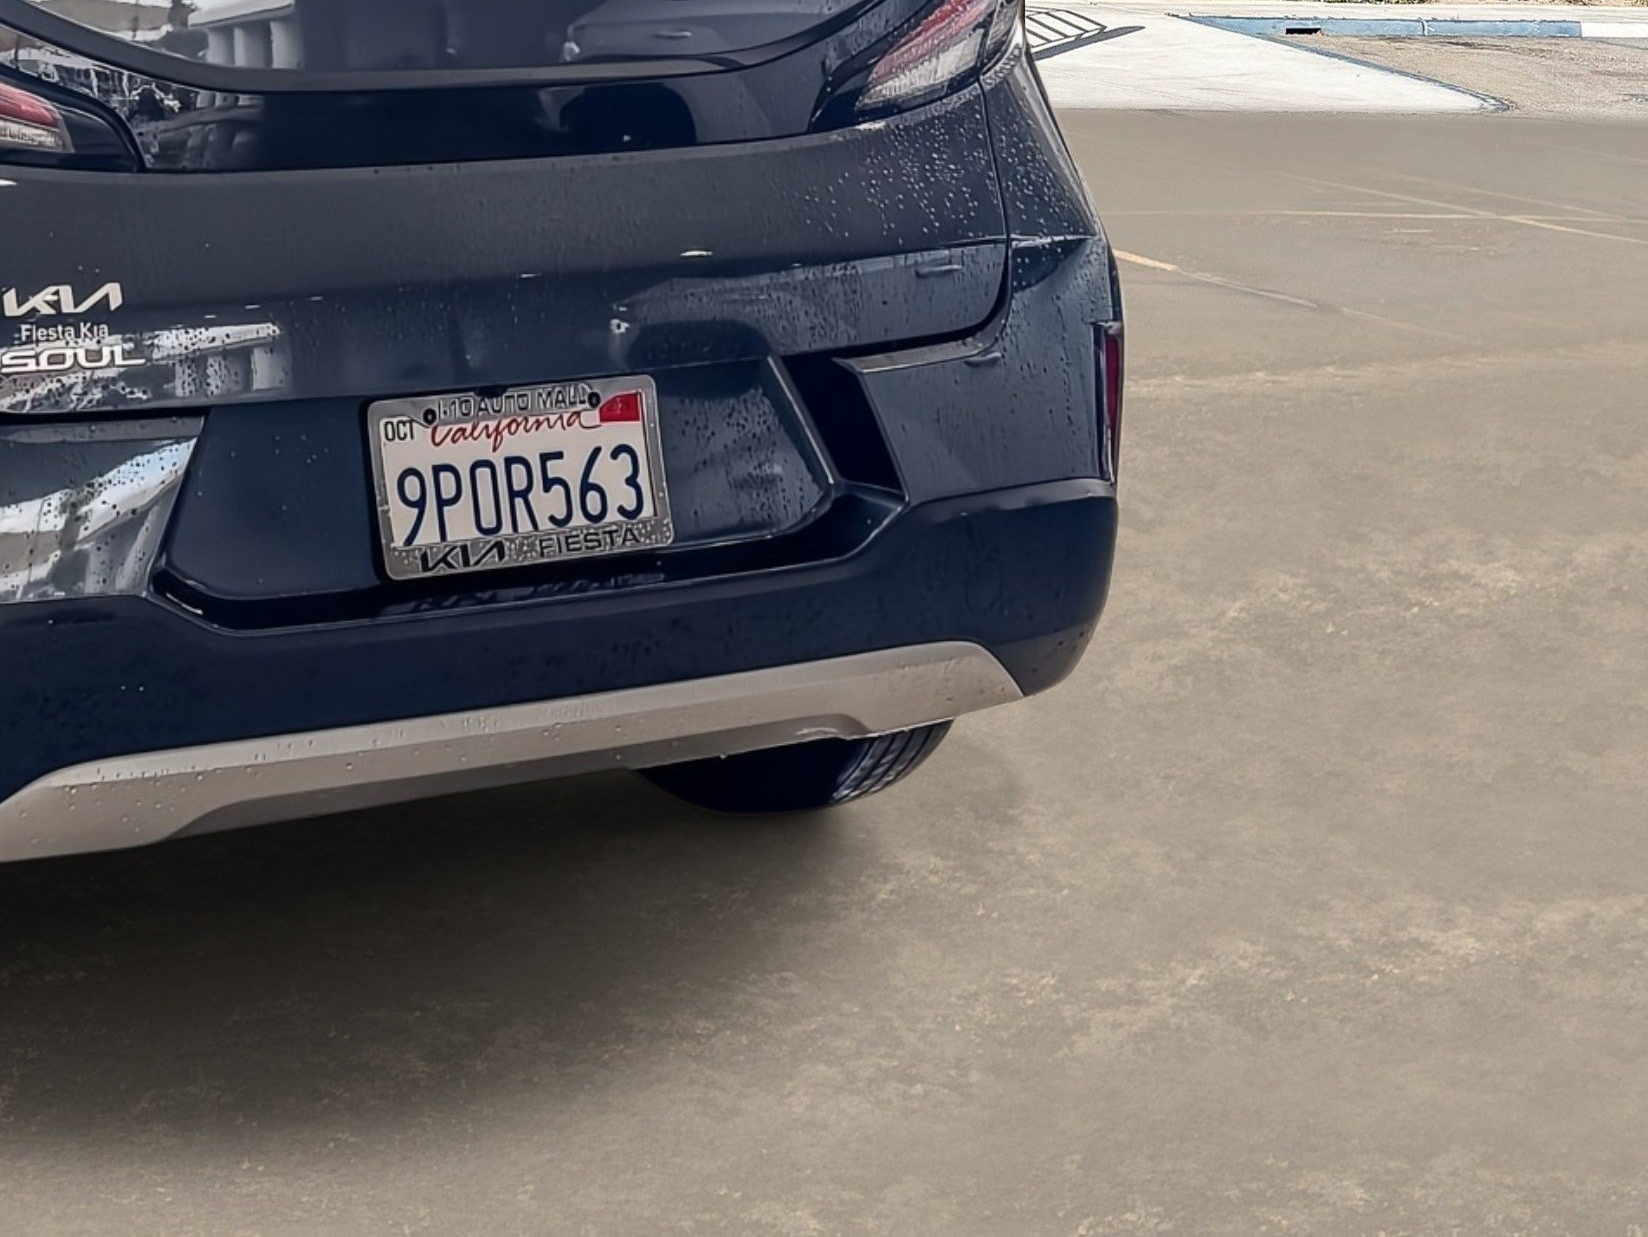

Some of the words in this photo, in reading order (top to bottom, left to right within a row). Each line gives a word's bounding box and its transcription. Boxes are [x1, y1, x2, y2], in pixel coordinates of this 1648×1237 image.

[3, 282, 123, 317] KIA
[20, 323, 74, 342] Fiesta
[79, 322, 109, 339] Kia
[1, 345, 146, 373] SOUL
[477, 391, 531, 415] AUTO
[537, 384, 593, 410] MALL
[384, 419, 415, 442] OCT
[431, 410, 602, 453] California
[396, 444, 644, 547] 9POR563
[419, 540, 506, 572] KIA
[539, 528, 640, 557] FIESTA
